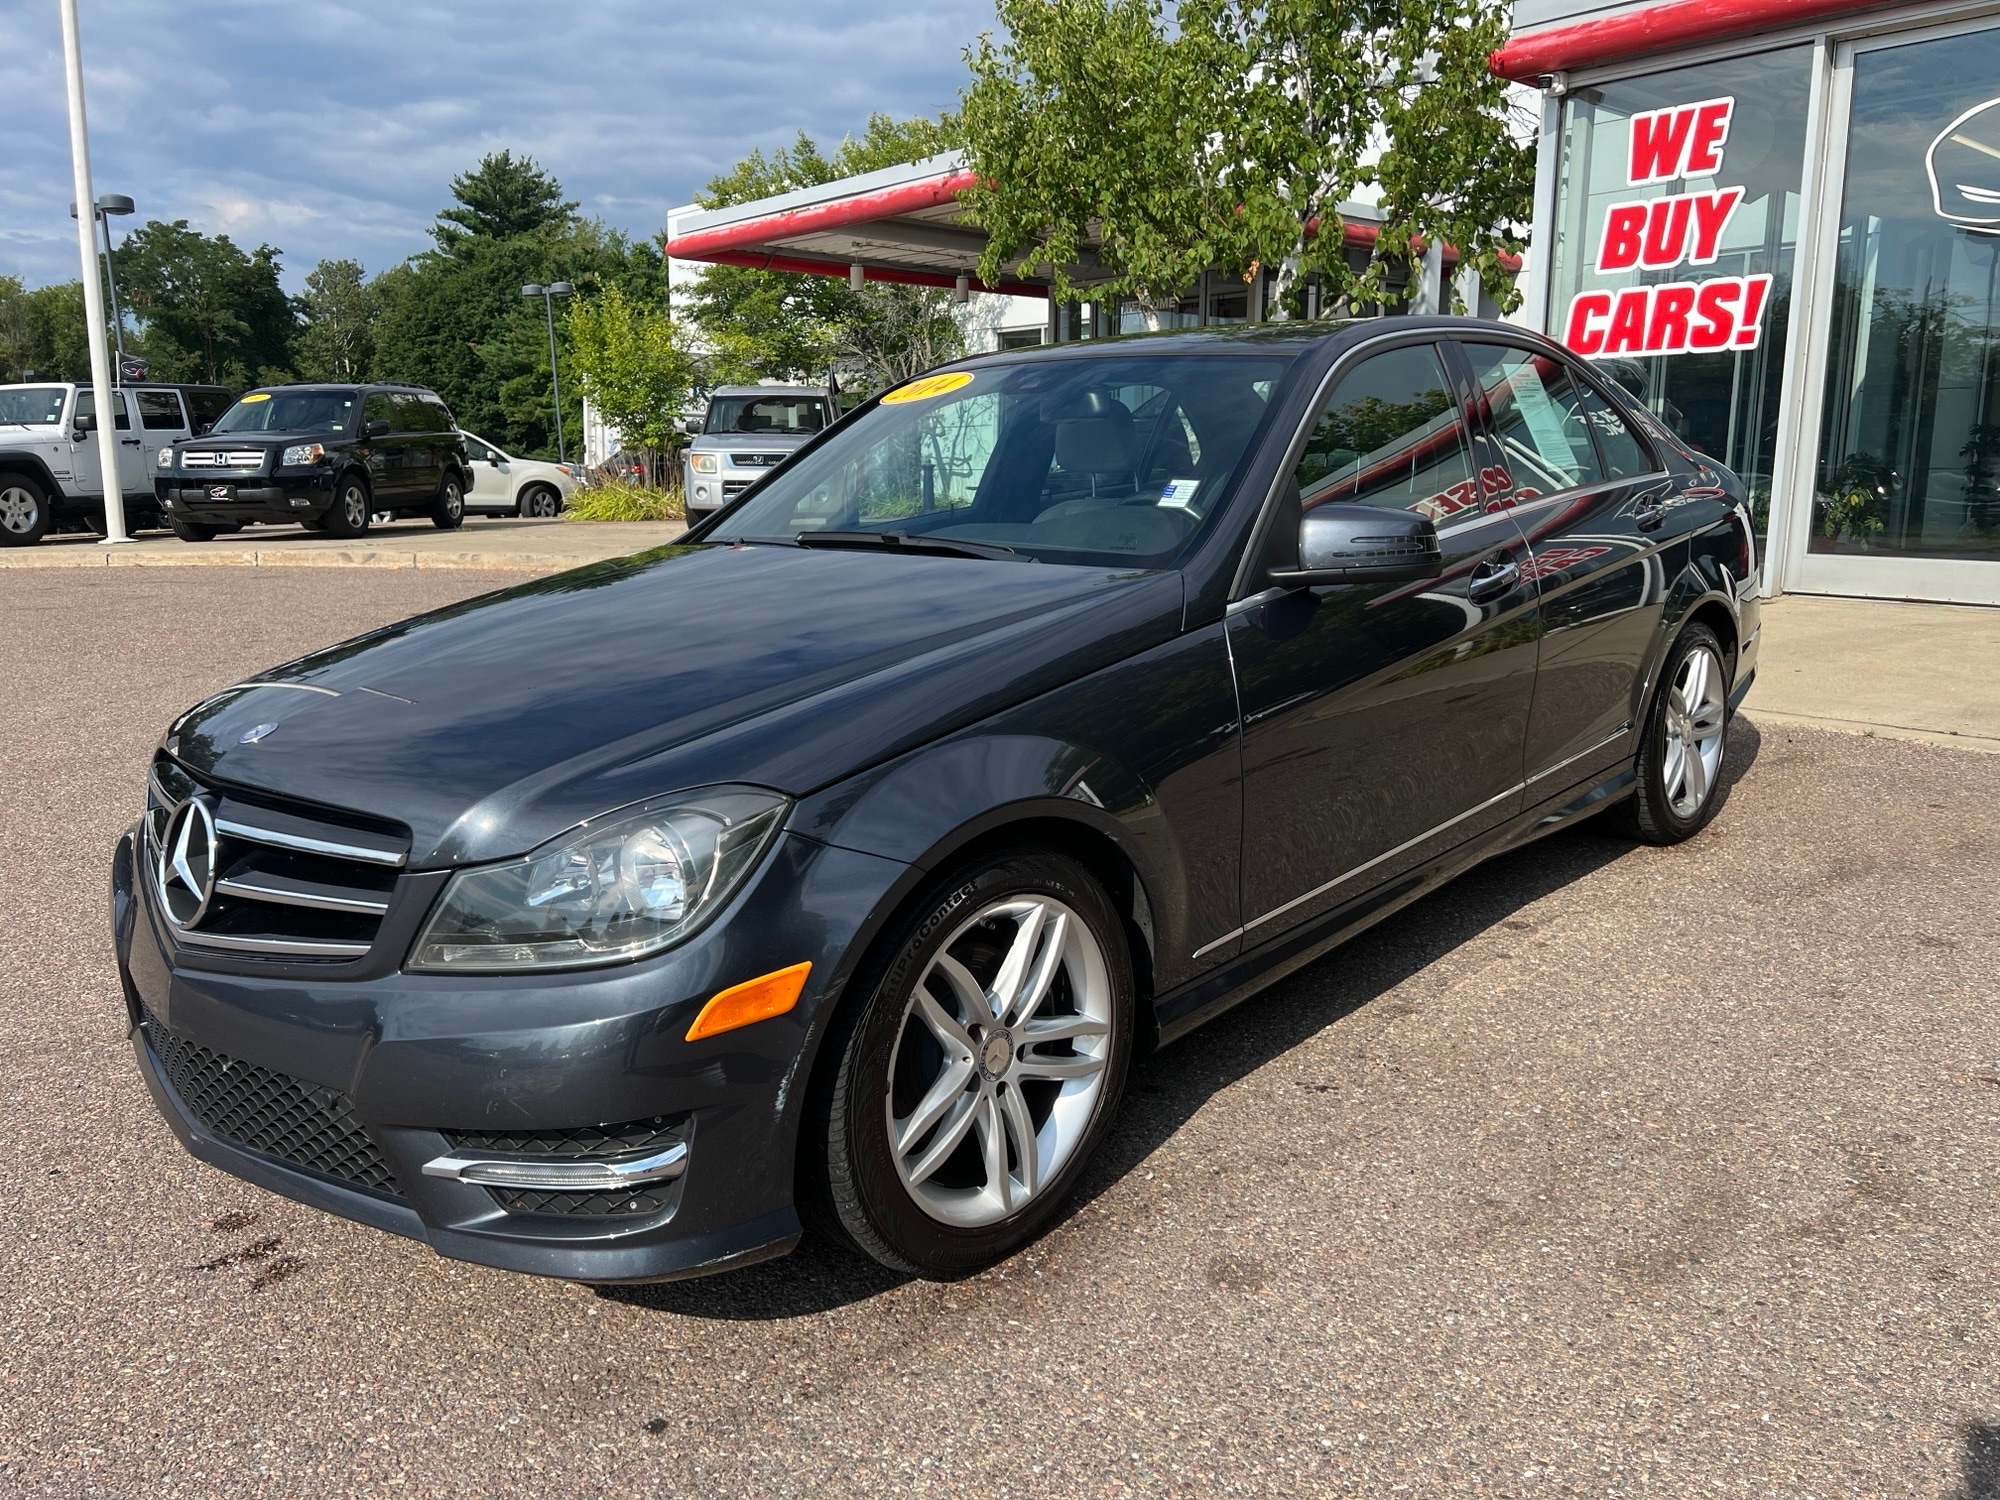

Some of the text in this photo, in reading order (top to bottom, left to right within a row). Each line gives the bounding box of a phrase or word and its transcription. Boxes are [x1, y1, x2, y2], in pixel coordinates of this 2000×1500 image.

[1628, 98, 1733, 184] WE
[1597, 187, 1743, 273] BUY
[1564, 276, 1771, 356] CARS!
